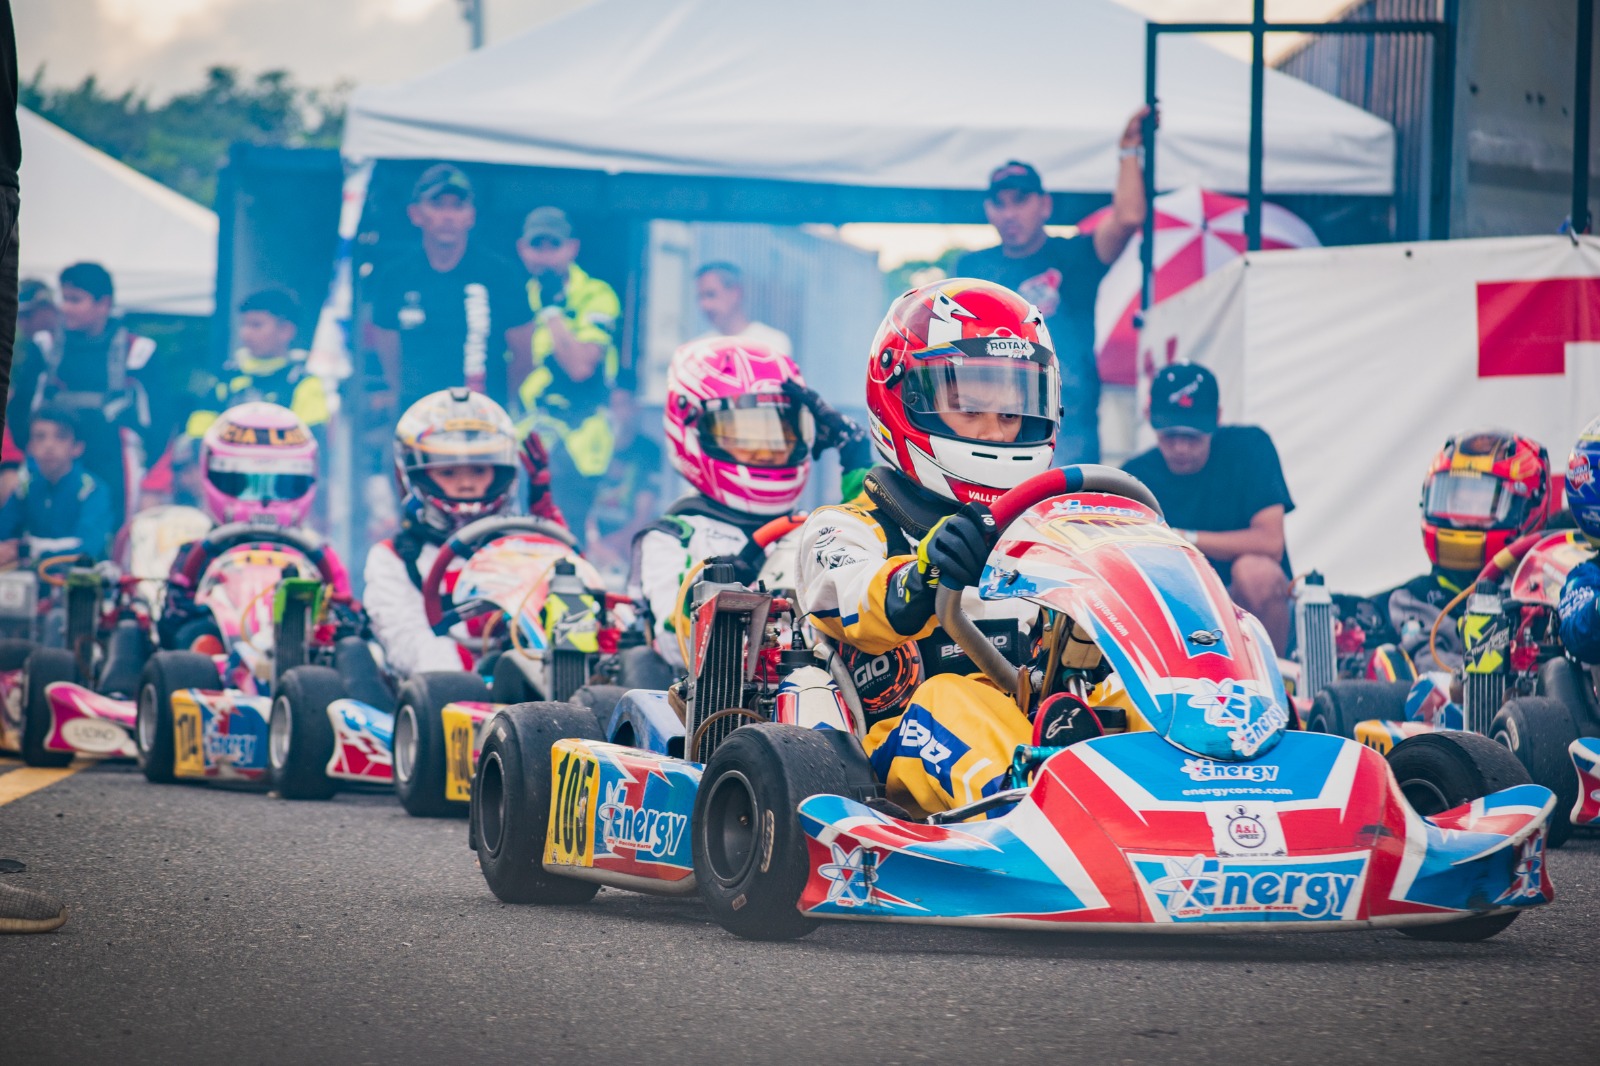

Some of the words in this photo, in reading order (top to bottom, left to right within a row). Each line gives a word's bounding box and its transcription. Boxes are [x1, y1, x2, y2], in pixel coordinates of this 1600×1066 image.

[989, 341, 1028, 351] ROTAX
[1087, 589, 1130, 637] gycorse.com
[940, 635, 1008, 658] BEIO
[1194, 760, 1277, 780] Energy
[1181, 787, 1294, 797] energycorse.com
[554, 751, 596, 857] 105
[603, 786, 687, 857] Energy
[1235, 824, 1259, 834] A&L
[1167, 858, 1358, 918] Energy
